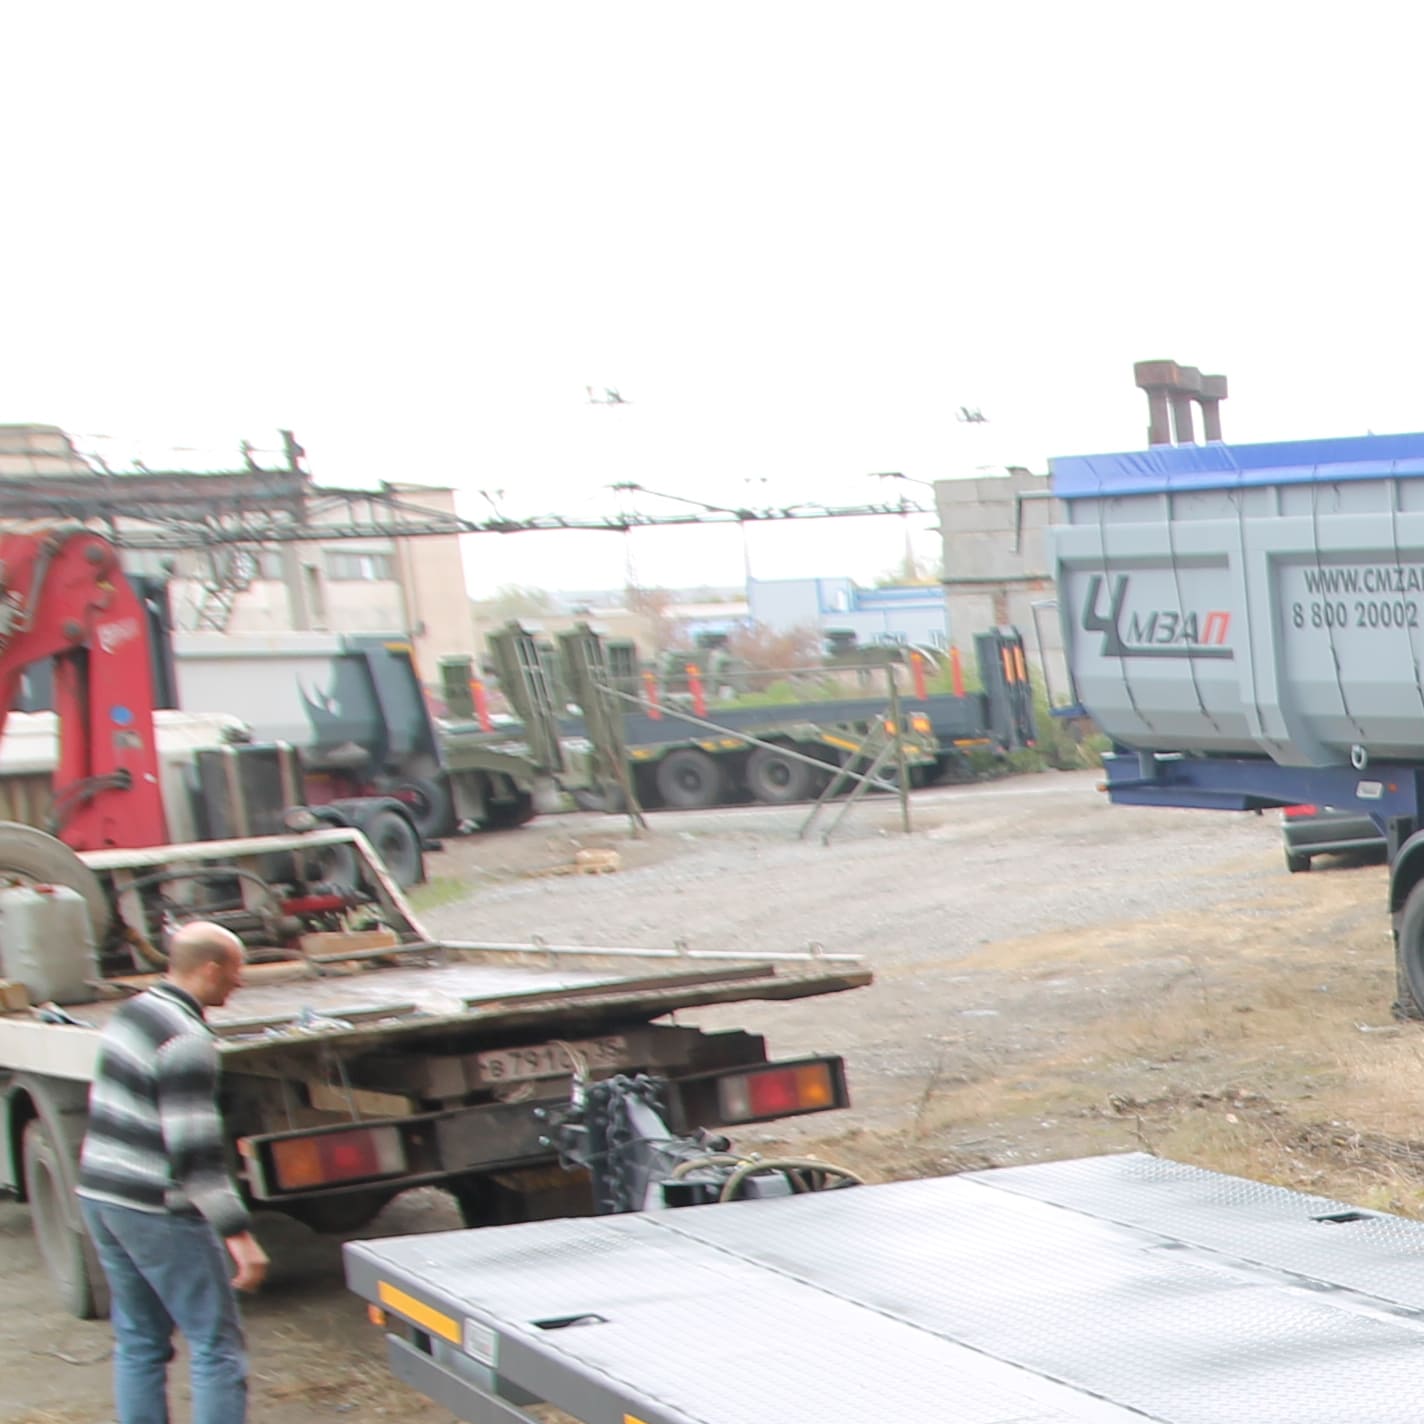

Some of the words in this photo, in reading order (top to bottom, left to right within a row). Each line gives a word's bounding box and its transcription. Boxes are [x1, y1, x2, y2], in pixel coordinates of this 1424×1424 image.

[1082, 574, 1233, 658] ЧМЗАП
[1293, 602, 1305, 628] 8
[1311, 602, 1347, 628] 800
[1354, 600, 1418, 628] 20002
